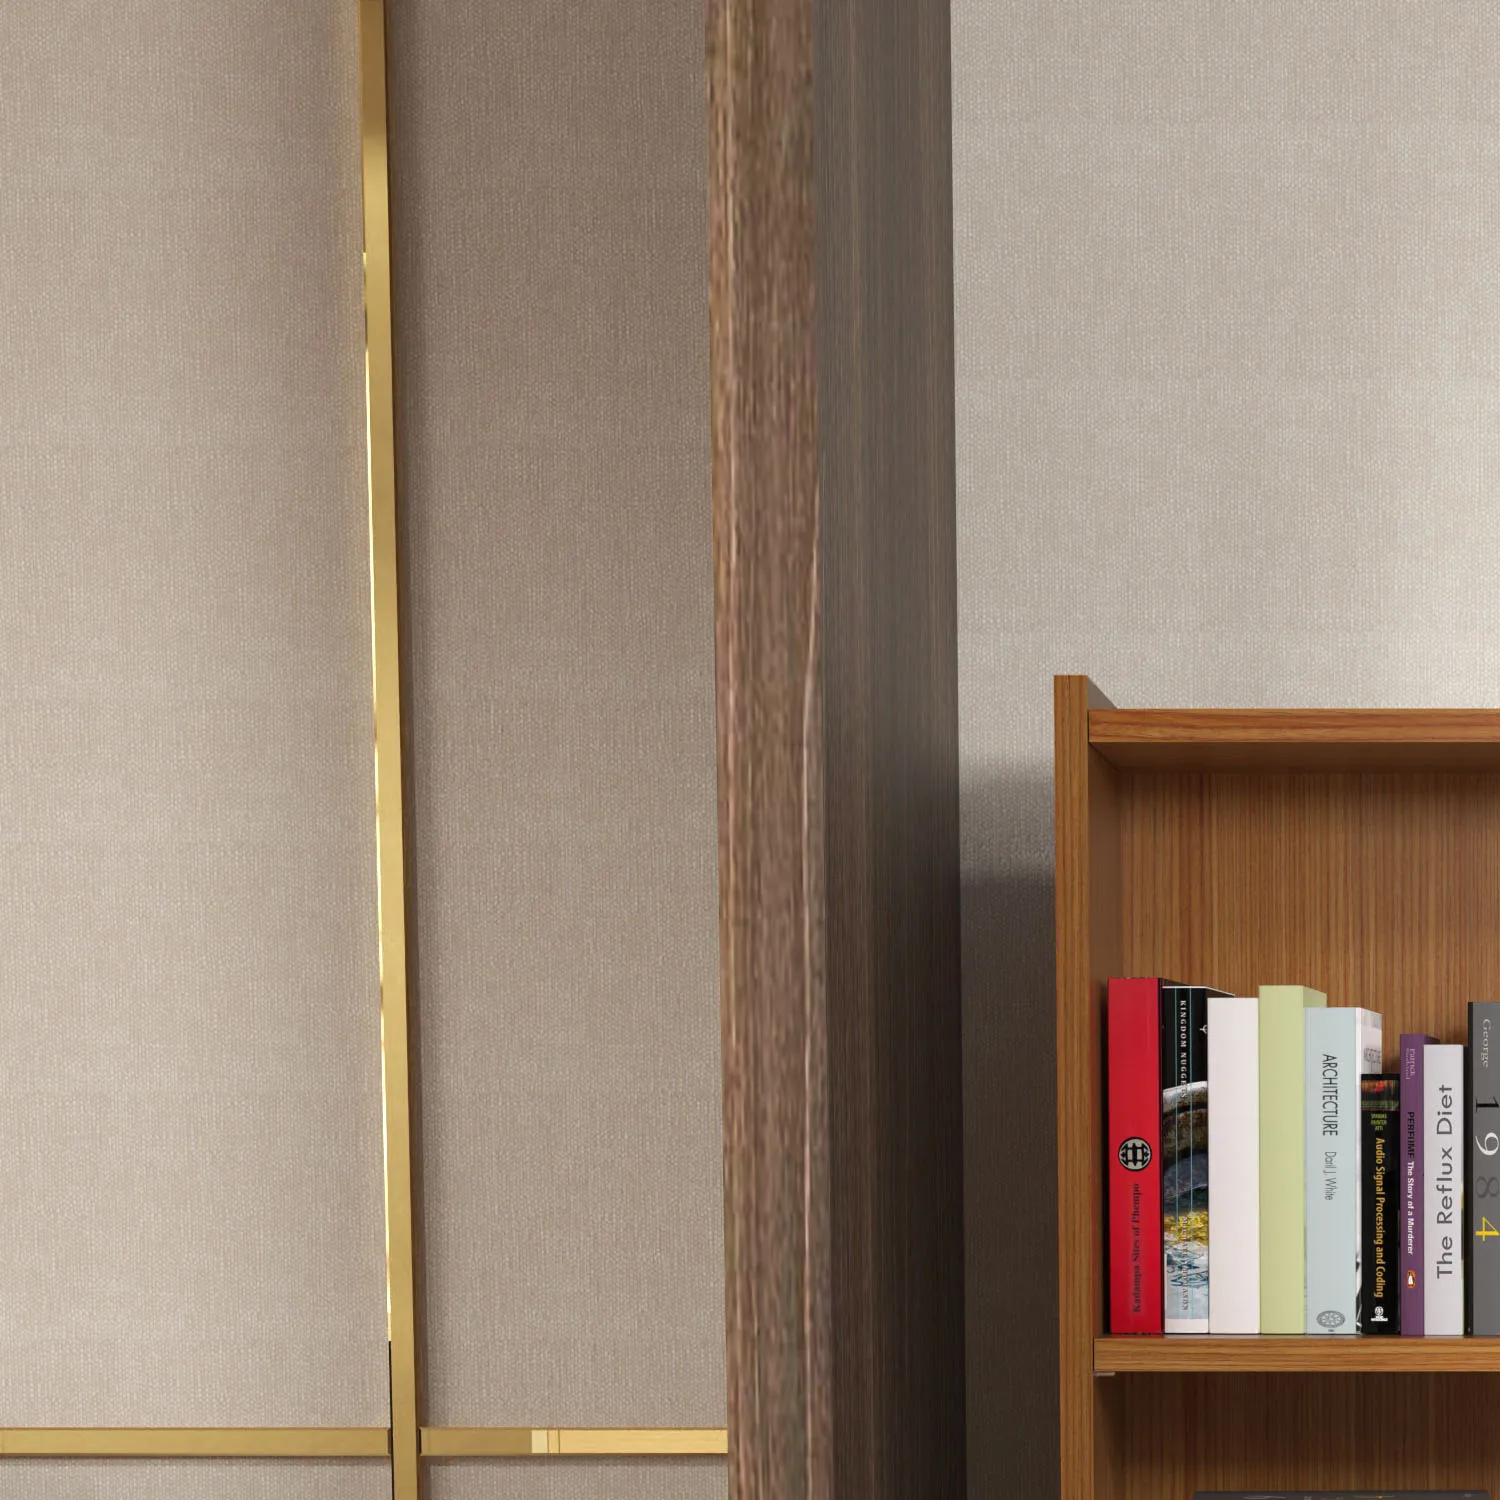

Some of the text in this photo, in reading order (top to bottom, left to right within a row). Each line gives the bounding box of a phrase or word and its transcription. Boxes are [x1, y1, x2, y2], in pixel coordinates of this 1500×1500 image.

[1481, 1018, 1492, 1068] George
[1322, 1053, 1338, 1137] ARCHITECTURE
[1407, 1161, 1415, 1176] The
[1436, 1084, 1453, 1279] The Reflux Diet
[1324, 1177, 1337, 1201] White
[1406, 1177, 1415, 1199] Story
[1373, 1137, 1386, 1298] Audio Signal Processing and Coding
[1407, 1200, 1415, 1209] of
[1131, 1226, 1141, 1237] of
[1407, 1218, 1415, 1255] Murderer
